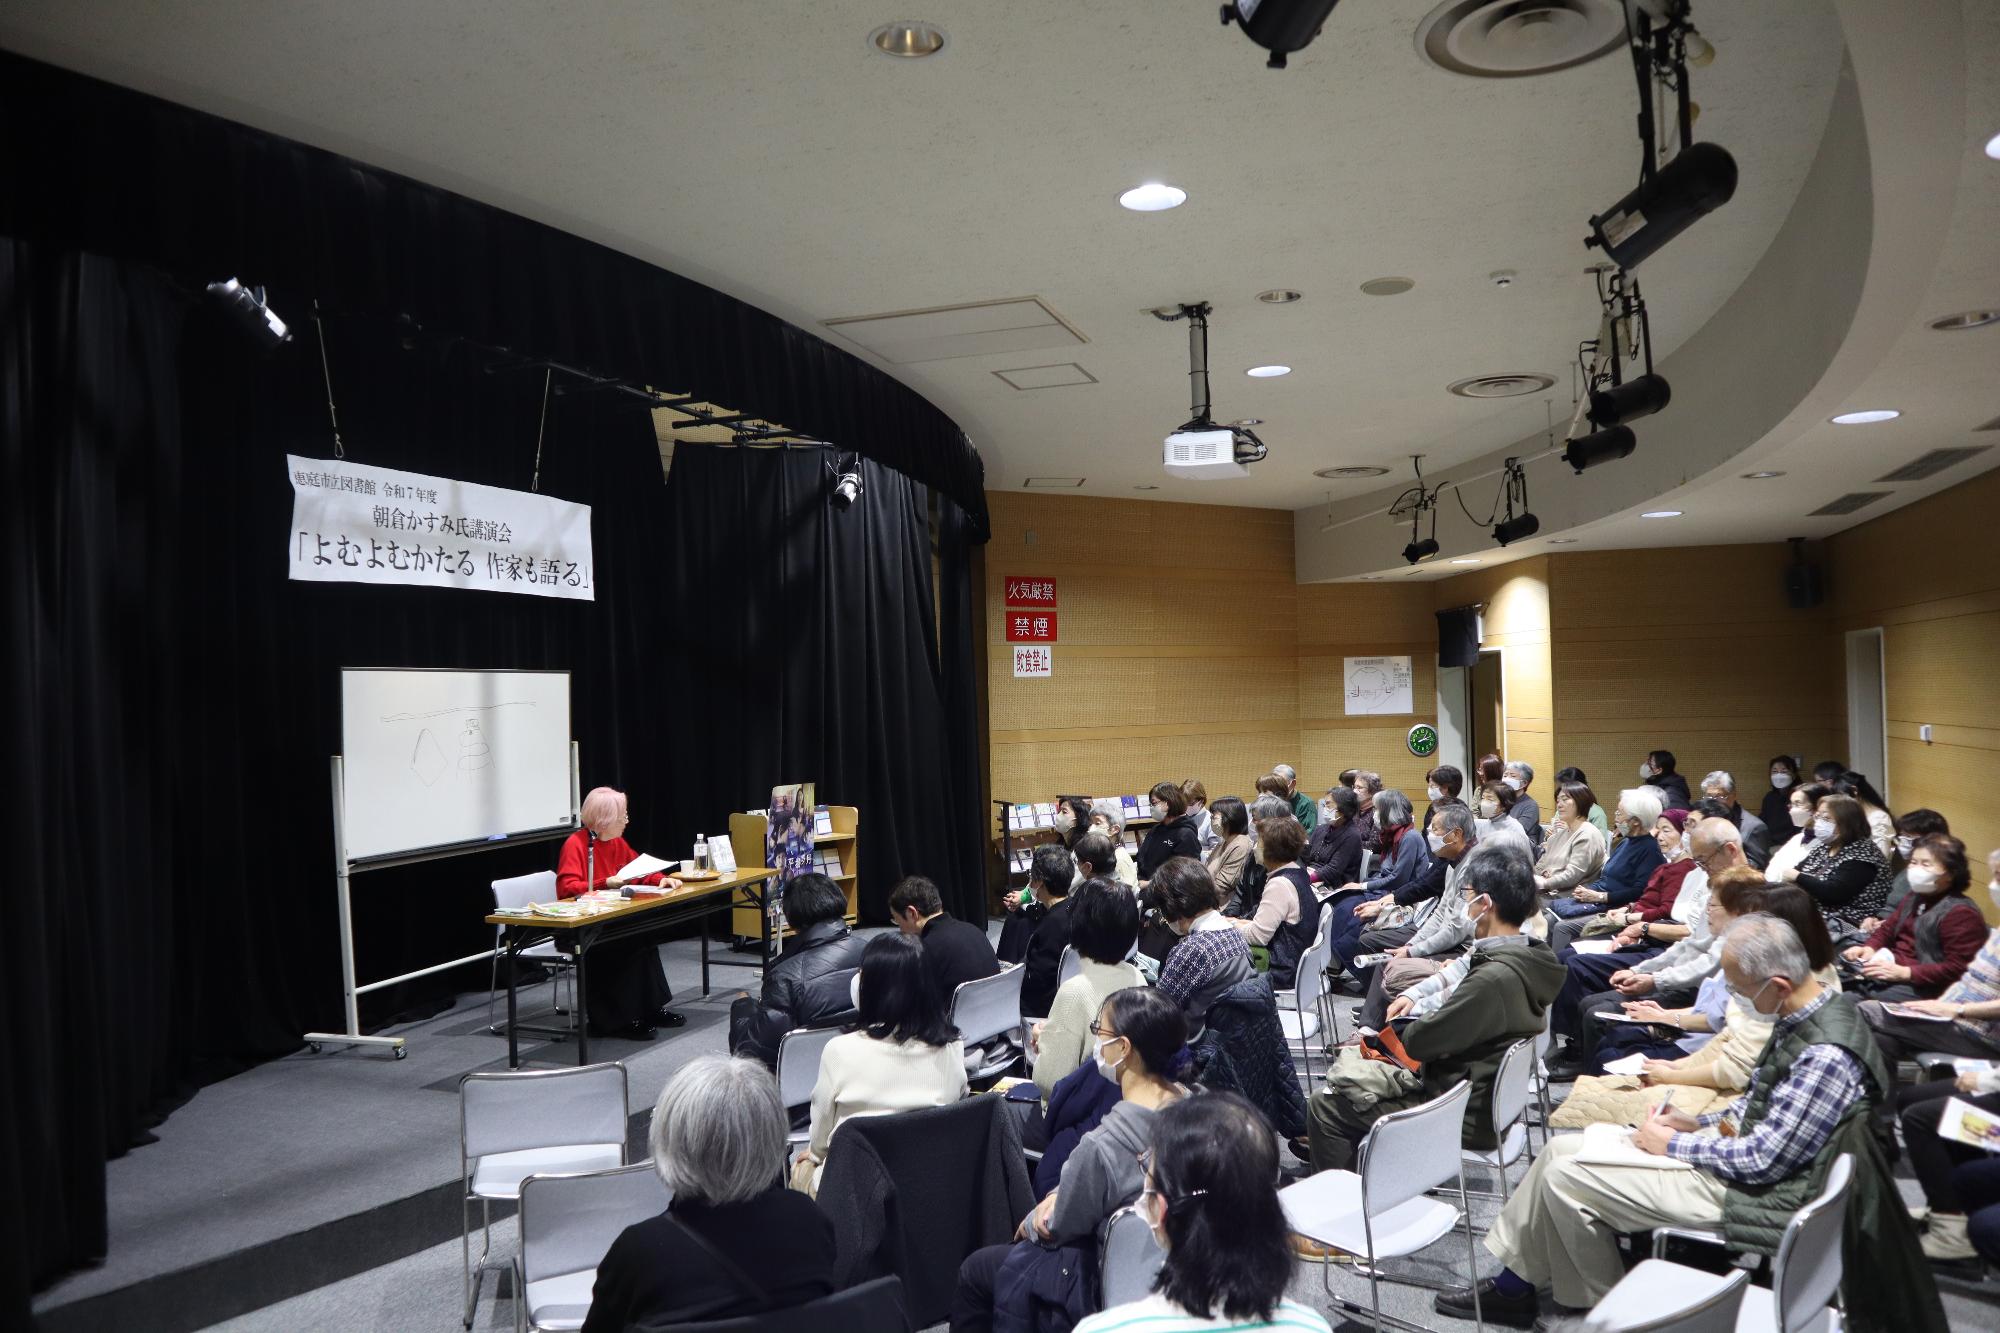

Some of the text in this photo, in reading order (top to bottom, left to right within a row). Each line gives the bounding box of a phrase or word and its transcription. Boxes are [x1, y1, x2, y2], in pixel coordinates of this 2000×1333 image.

[294, 471, 438, 504] 恵庭市立図書館 令和7年度
[372, 505, 512, 544] 朝倉かすみ氏講演会
[486, 551, 590, 589] 作家も語る」
[1009, 581, 1054, 600] 火気厳禁
[1015, 617, 1048, 637] 禁煙
[1016, 649, 1049, 673] 飲食禁止
